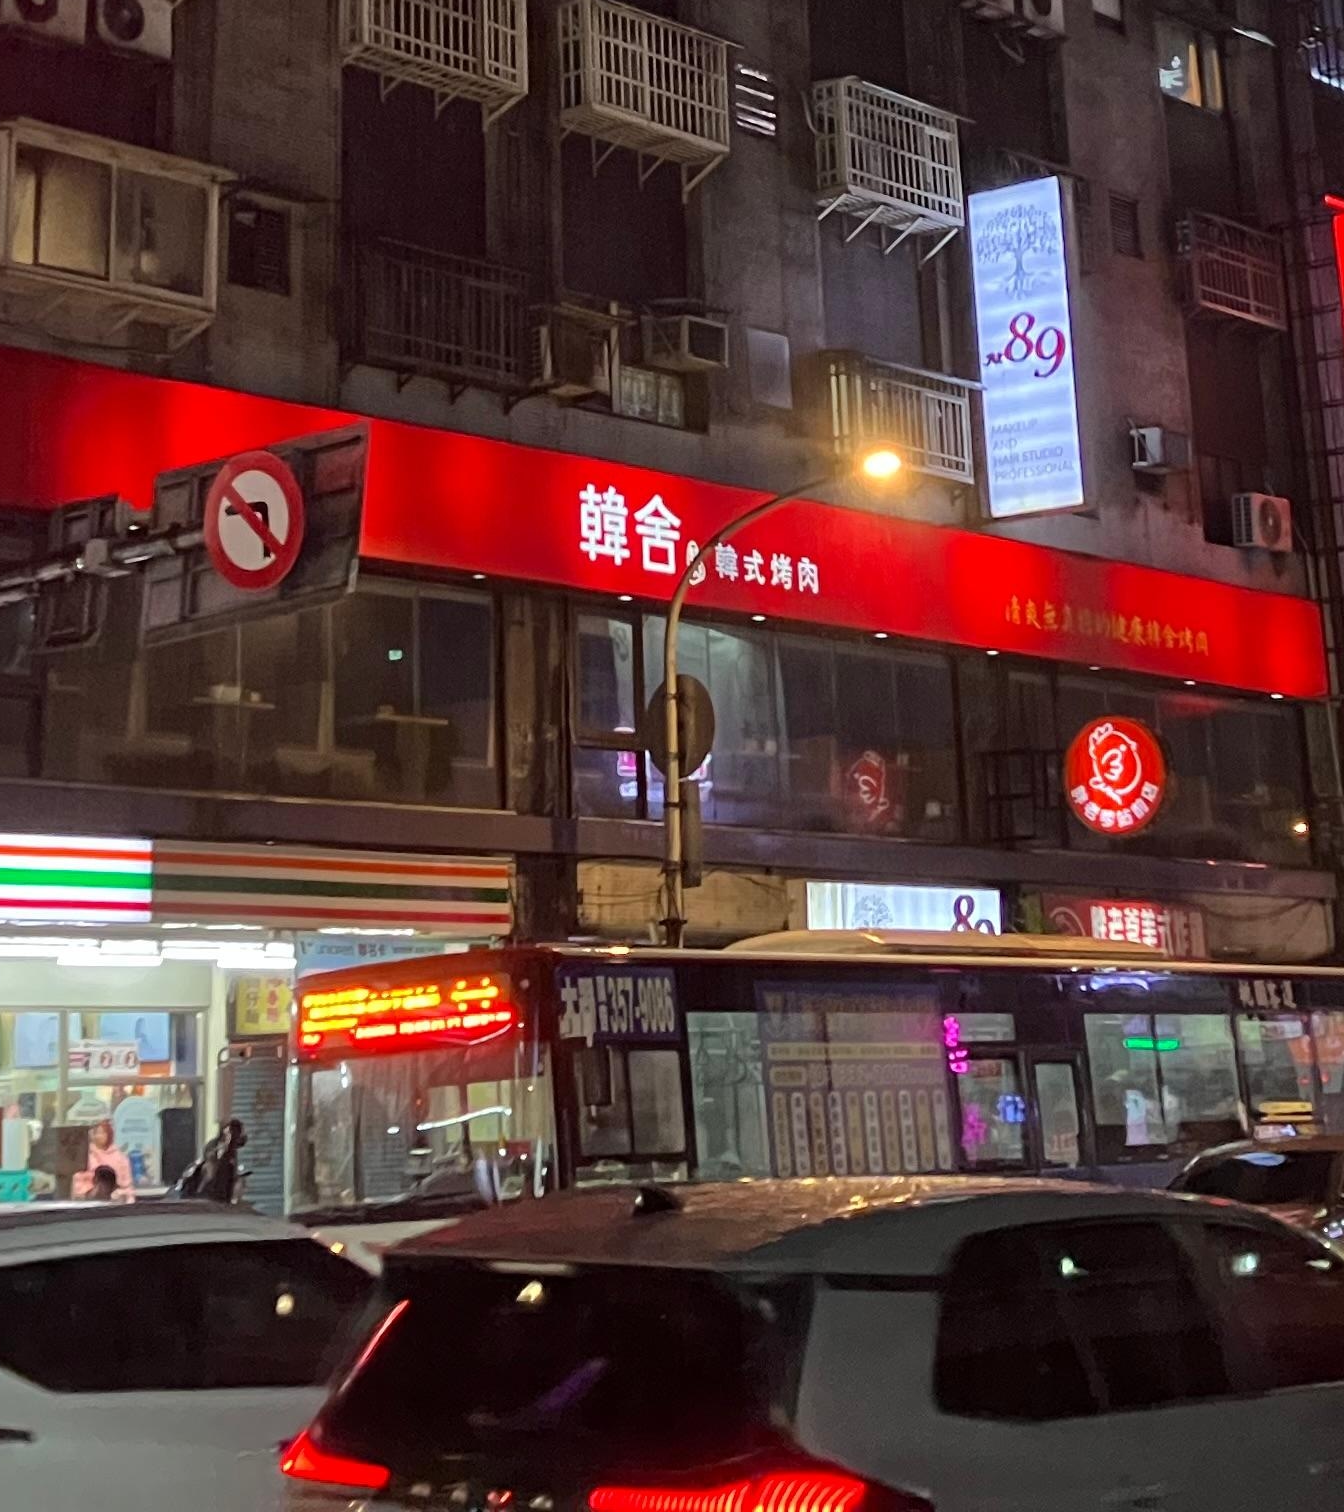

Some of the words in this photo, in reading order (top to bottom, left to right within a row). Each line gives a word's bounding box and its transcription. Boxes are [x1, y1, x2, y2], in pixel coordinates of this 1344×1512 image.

[990, 418, 1039, 437] MAKEUP
[992, 437, 1017, 451] AND
[993, 451, 1020, 468] HAIR
[1021, 445, 1064, 463] STUDIO
[994, 461, 1076, 481] PROFESSIONAL
[578, 482, 682, 576] 韓舍
[713, 541, 821, 595] 韓式烤肉
